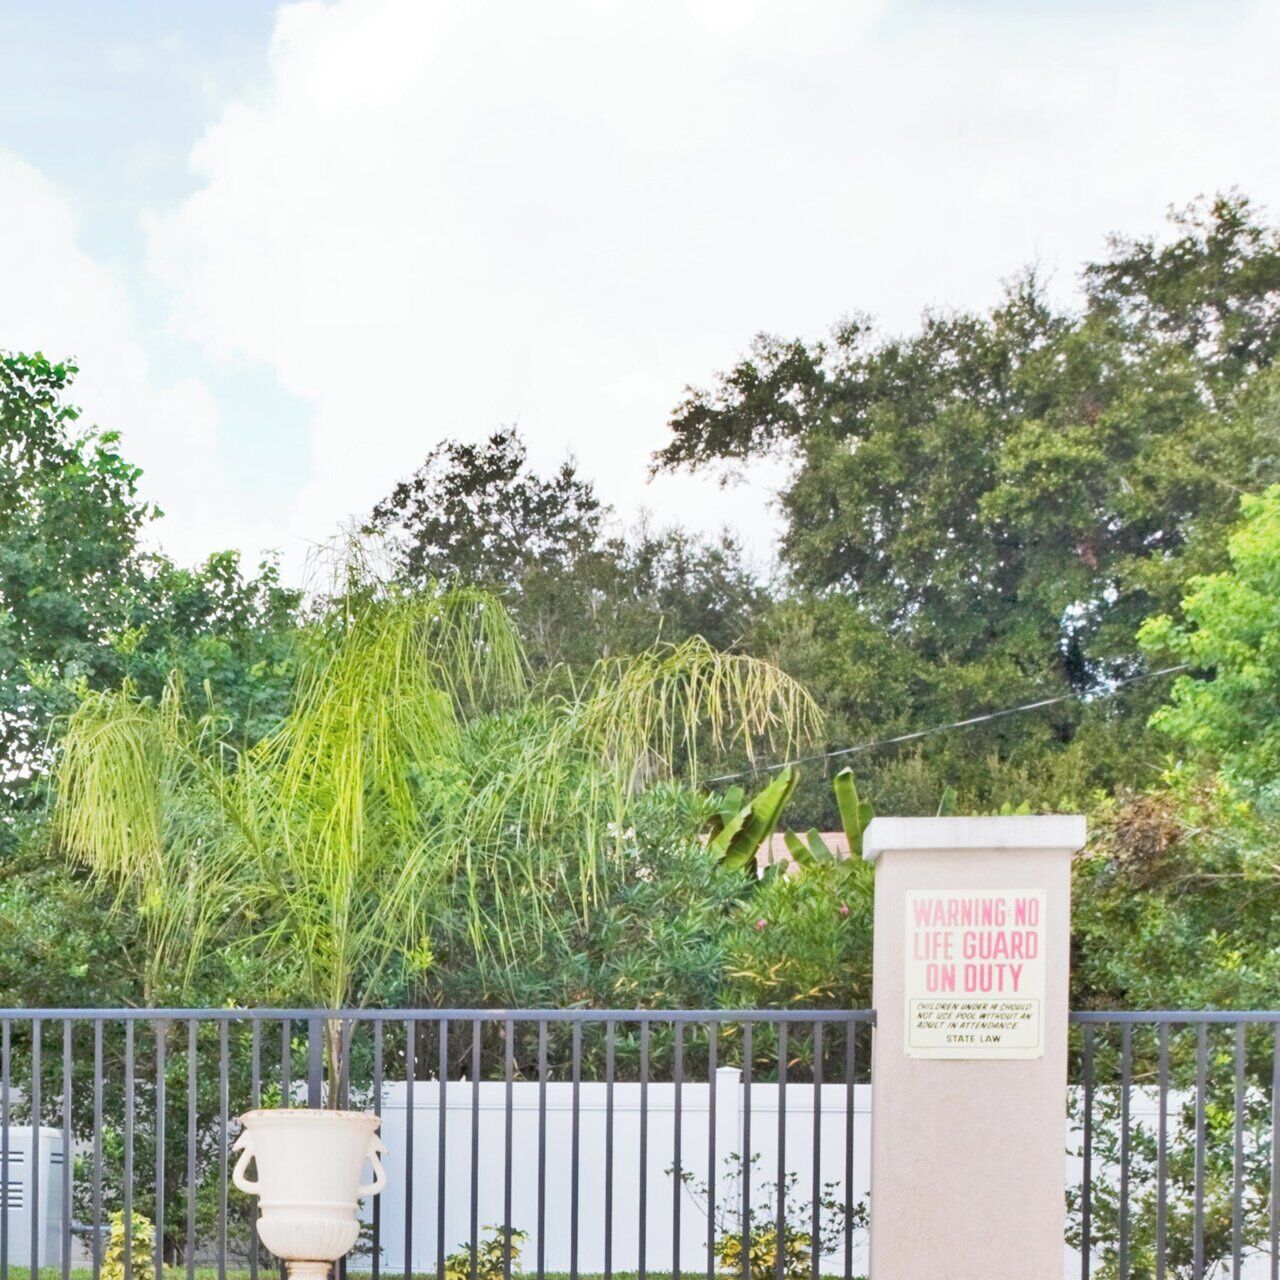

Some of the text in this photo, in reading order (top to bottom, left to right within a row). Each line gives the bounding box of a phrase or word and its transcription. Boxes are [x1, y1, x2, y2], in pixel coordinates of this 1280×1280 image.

[1014, 898, 1039, 927] NO
[913, 931, 1038, 960] LIFE GUARD
[926, 963, 1023, 992] ON DUTY
